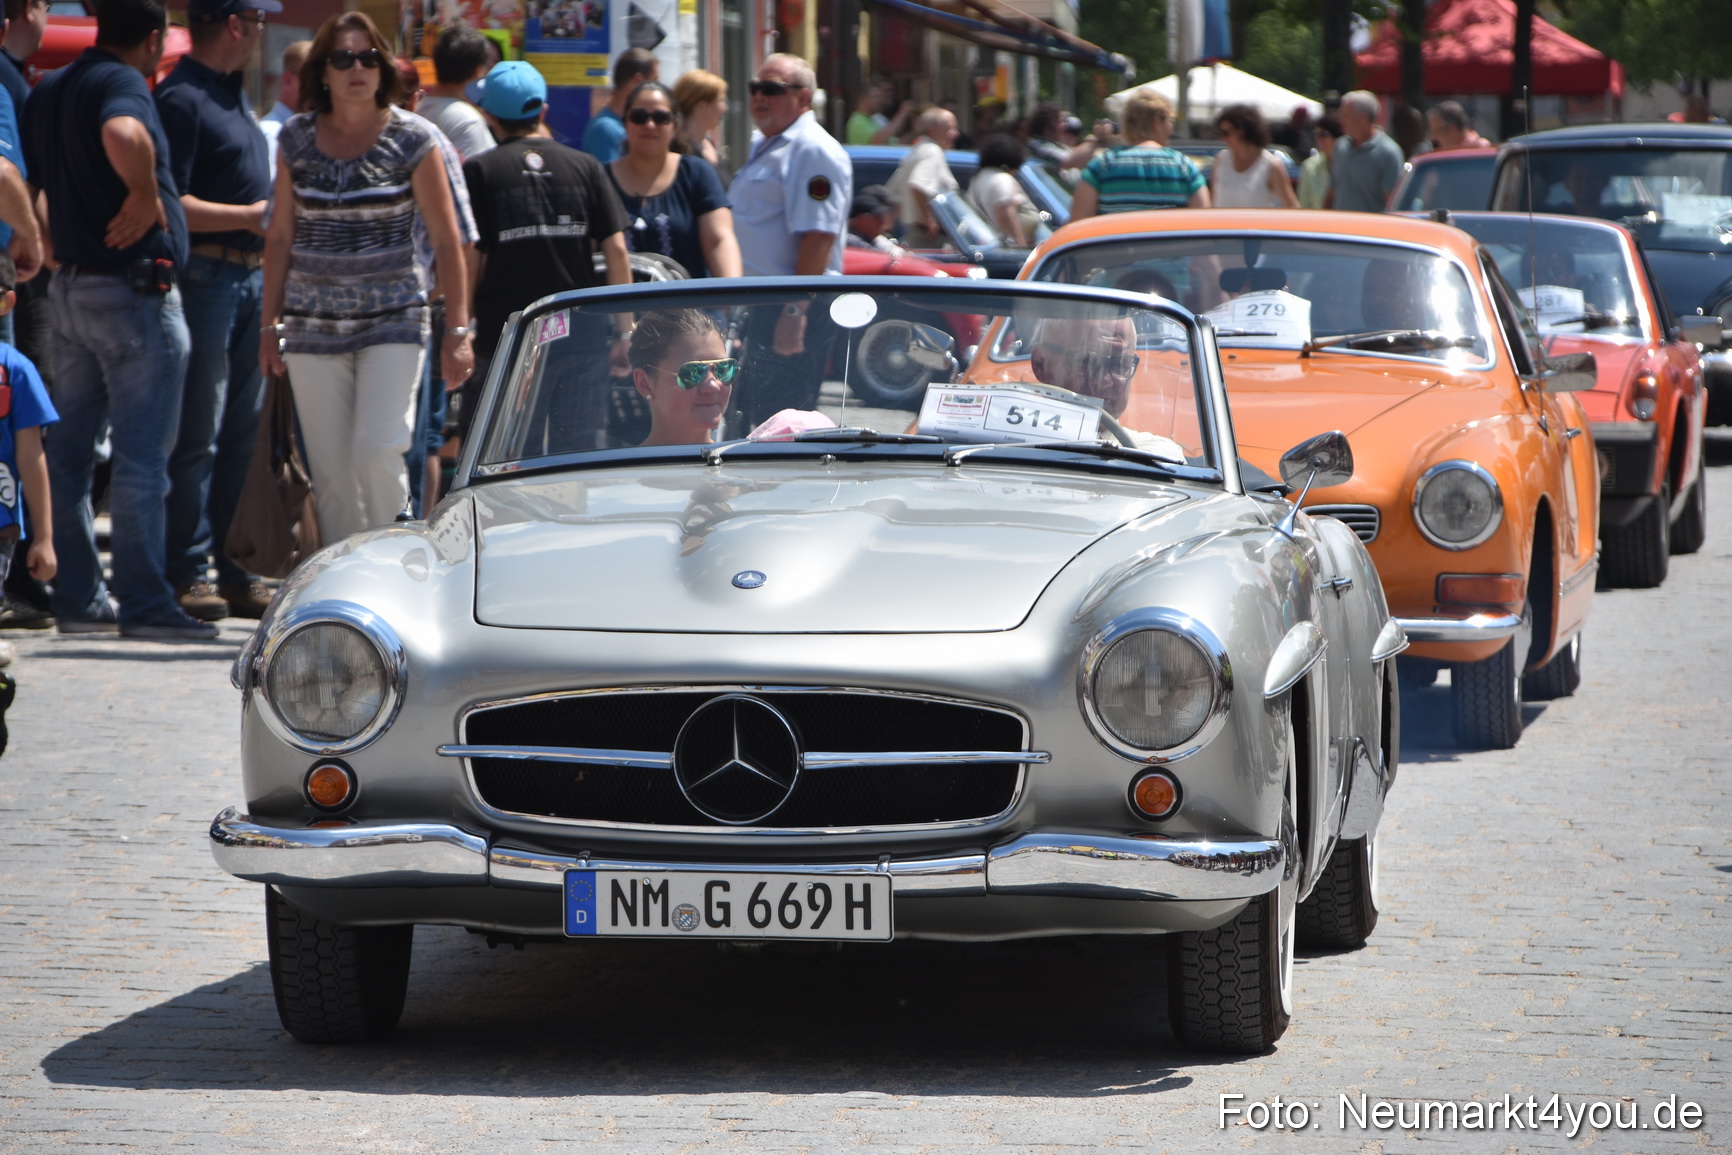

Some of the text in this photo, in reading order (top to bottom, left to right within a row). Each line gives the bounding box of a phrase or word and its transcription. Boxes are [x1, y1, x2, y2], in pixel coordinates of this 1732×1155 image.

[1536, 294, 1563, 307] 287
[1246, 303, 1286, 317] 279
[1005, 404, 1063, 431] 514
[610, 878, 669, 928] NM
[704, 880, 731, 929] G
[747, 881, 832, 930] 669
[844, 882, 872, 931] H
[575, 909, 588, 924] D
